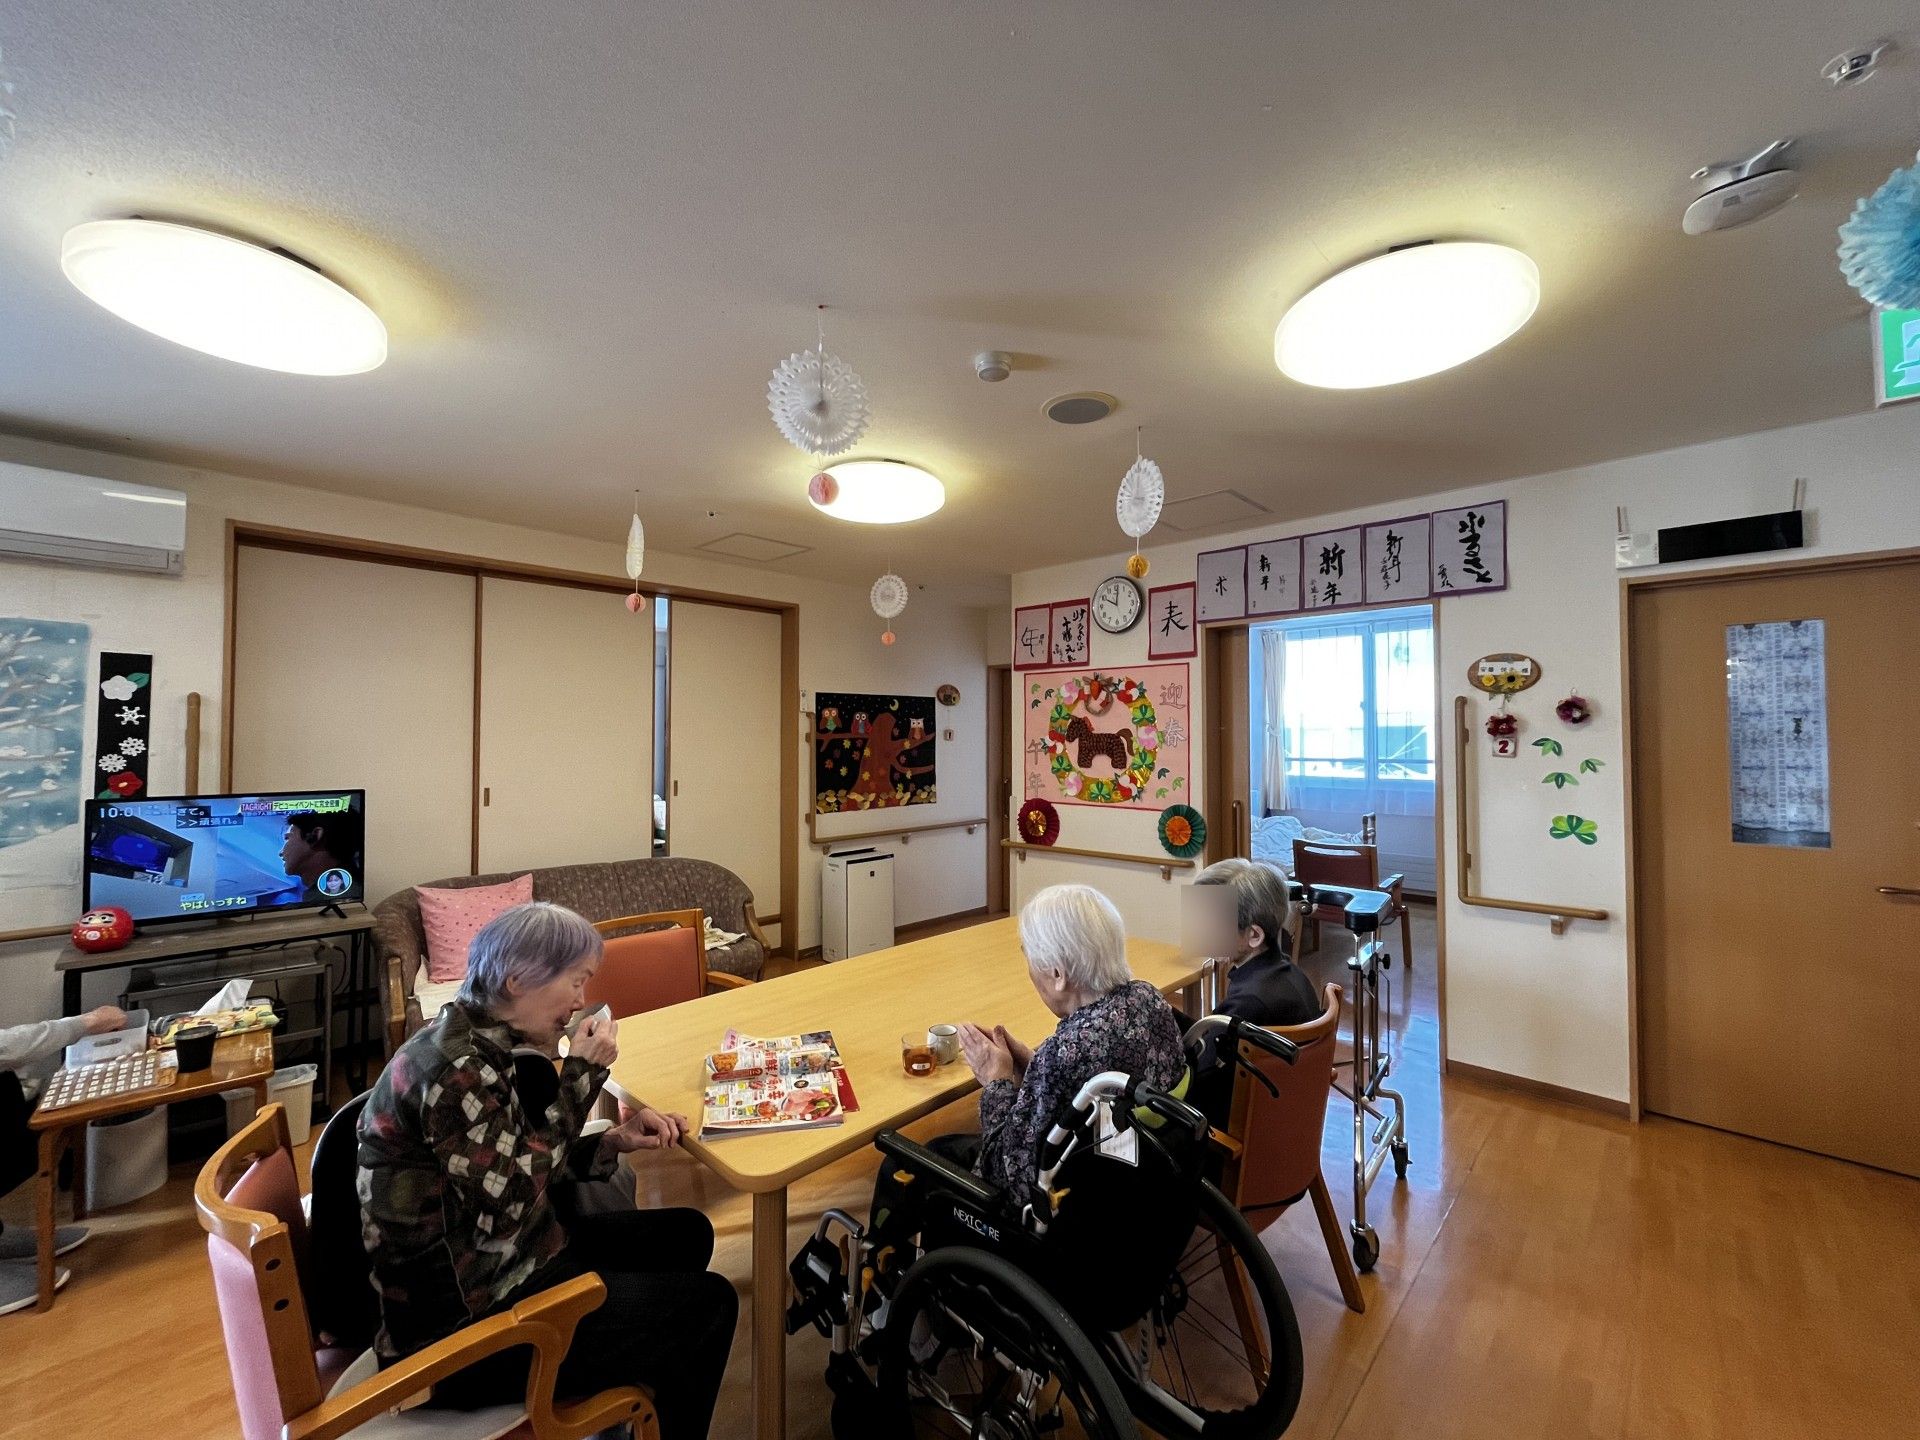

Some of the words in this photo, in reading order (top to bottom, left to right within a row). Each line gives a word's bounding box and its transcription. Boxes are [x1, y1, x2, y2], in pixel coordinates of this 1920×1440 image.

[1259, 554, 1271, 591] 新年
[1319, 542, 1346, 605] 新年
[1161, 601, 1189, 637] 表
[1159, 682, 1187, 747] 迎春
[1498, 740, 1509, 753] 2
